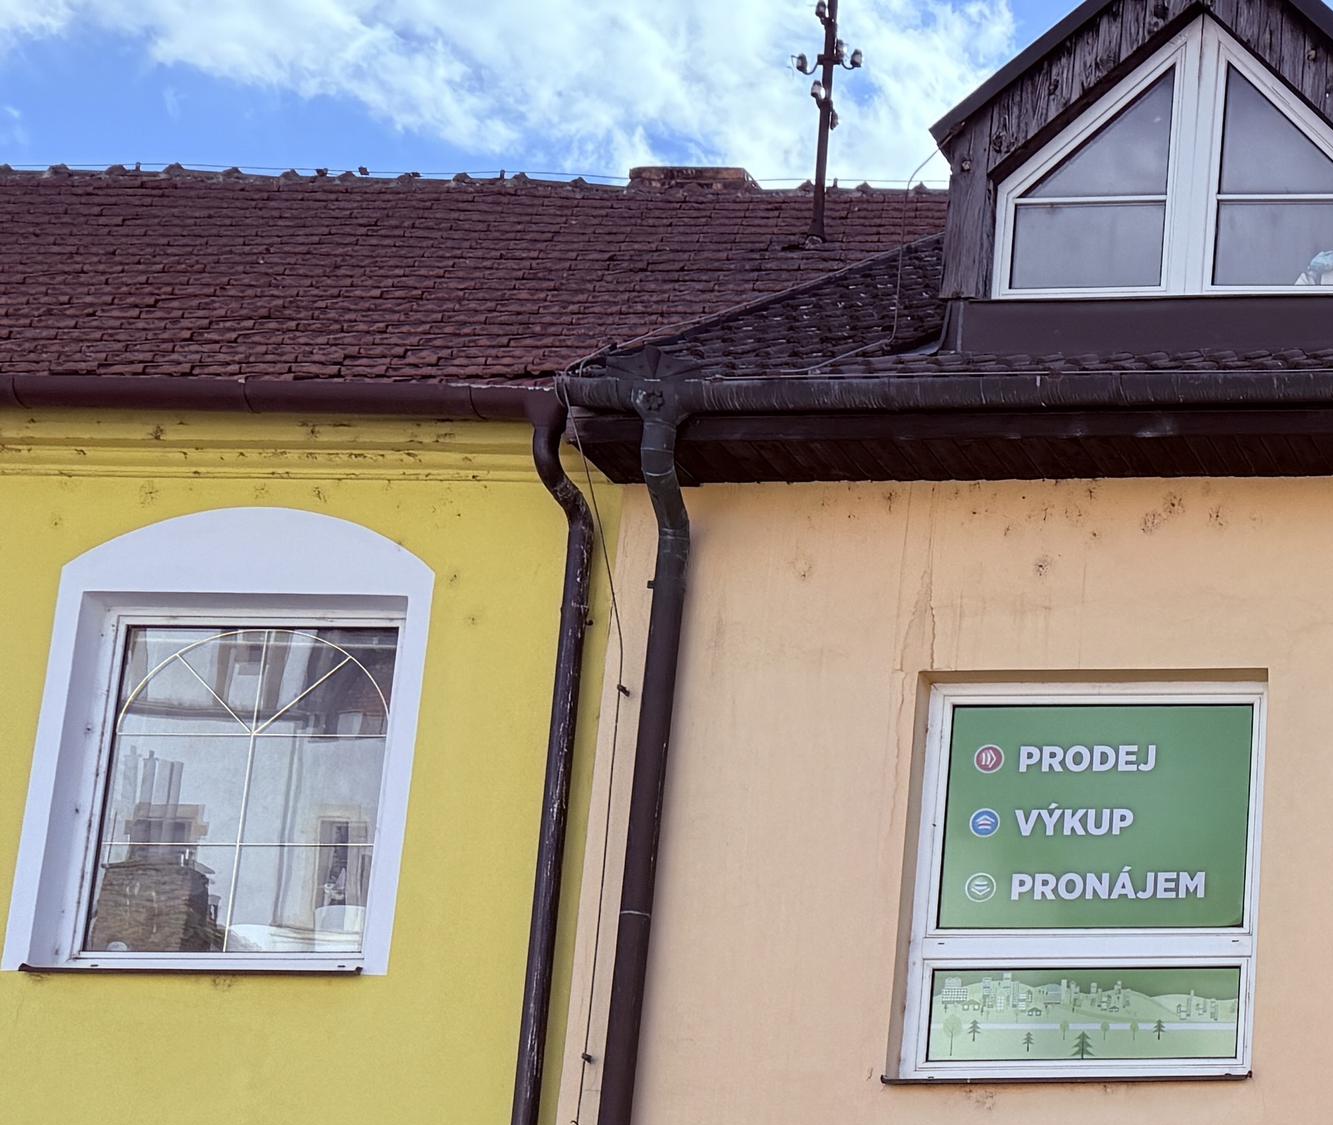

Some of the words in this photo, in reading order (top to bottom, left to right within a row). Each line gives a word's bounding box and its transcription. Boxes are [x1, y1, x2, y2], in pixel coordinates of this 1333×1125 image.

[1018, 745, 1156, 773] PRODEJ
[1015, 803, 1134, 837] VÝKUP
[1010, 867, 1207, 901] PRONÁJEM
